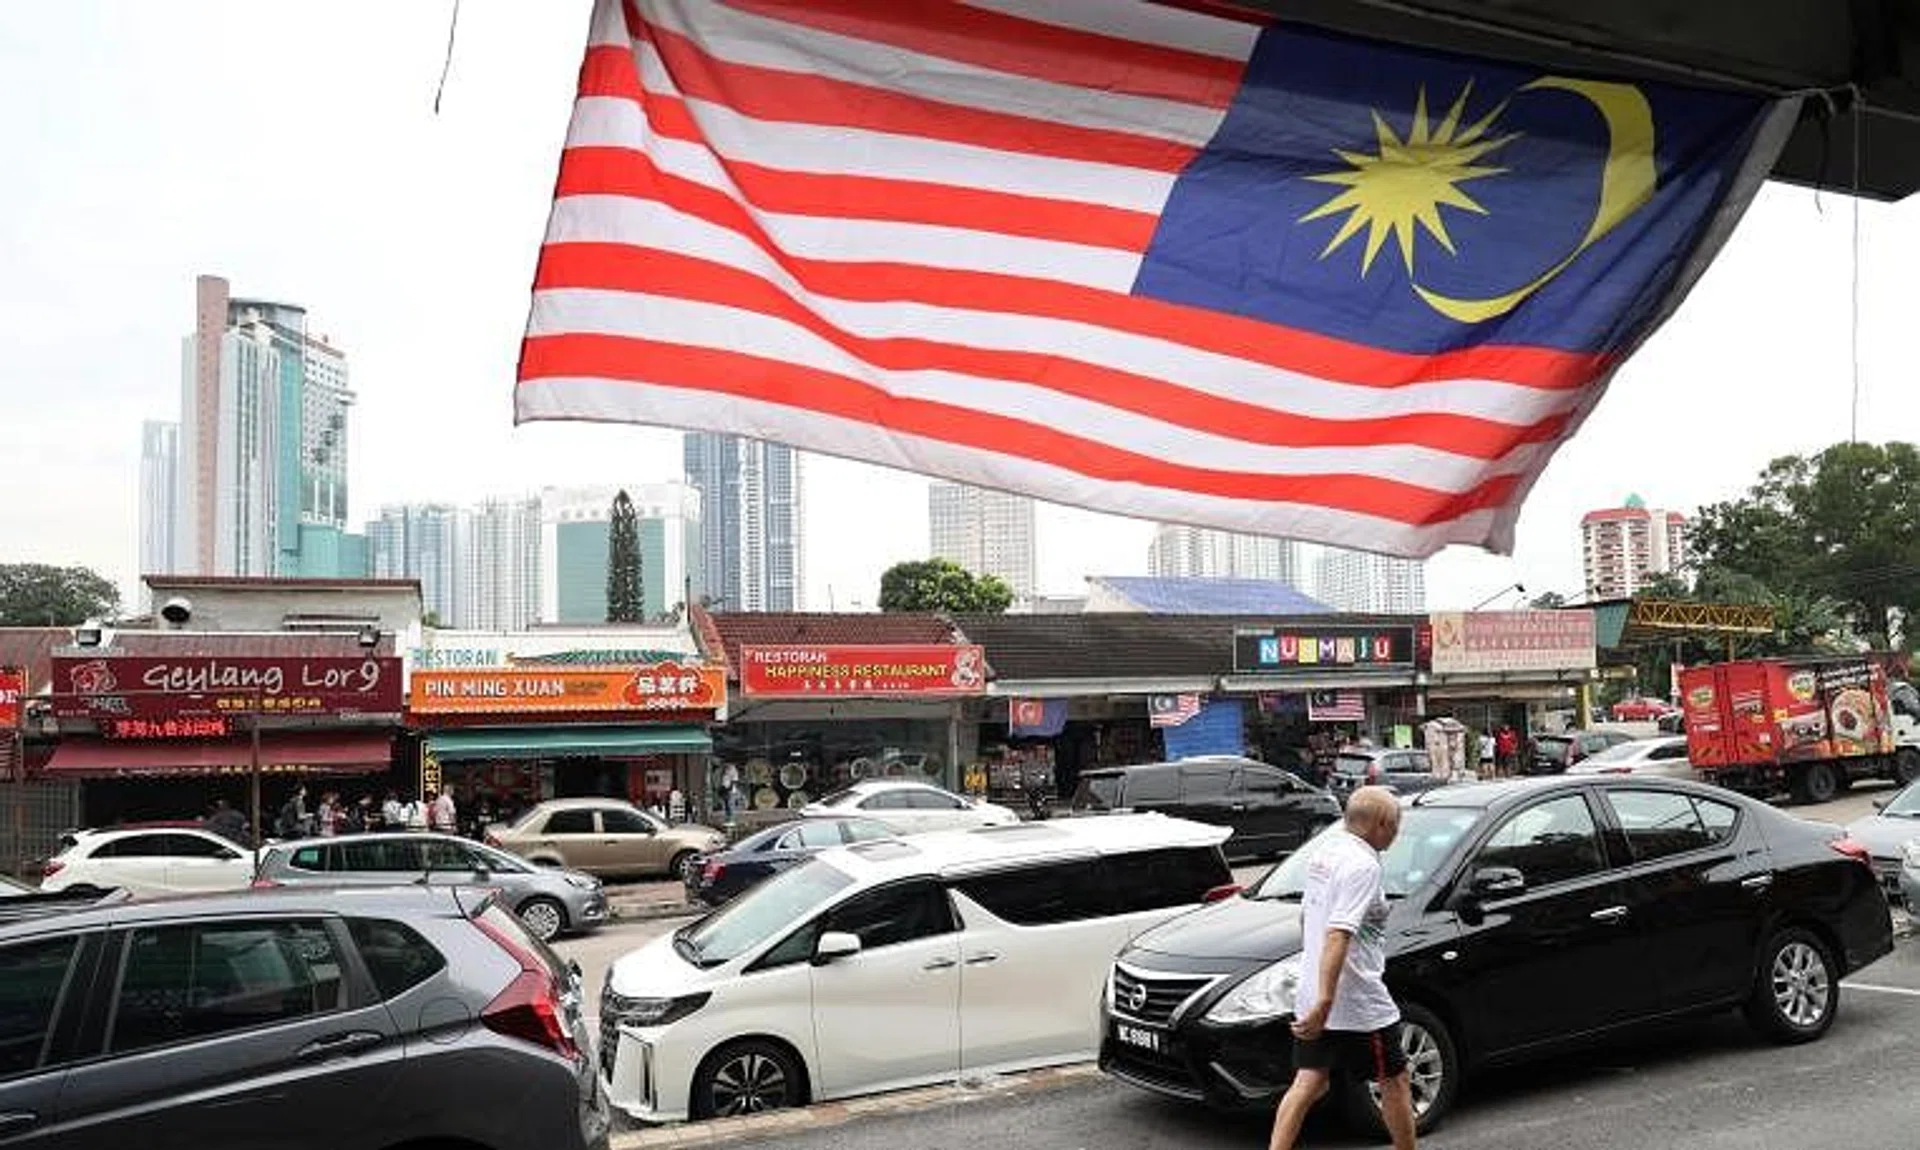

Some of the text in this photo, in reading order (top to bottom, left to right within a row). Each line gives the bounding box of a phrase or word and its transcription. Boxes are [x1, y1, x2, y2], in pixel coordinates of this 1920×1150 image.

[413, 649, 498, 667] RESTORAN
[754, 652, 827, 663] RESTORAN
[143, 660, 283, 693] Geylang
[765, 664, 947, 678] HAPPINESS RESTAURANT
[425, 680, 454, 696] PIN
[461, 680, 506, 696] MING
[511, 680, 565, 696] XUAN
